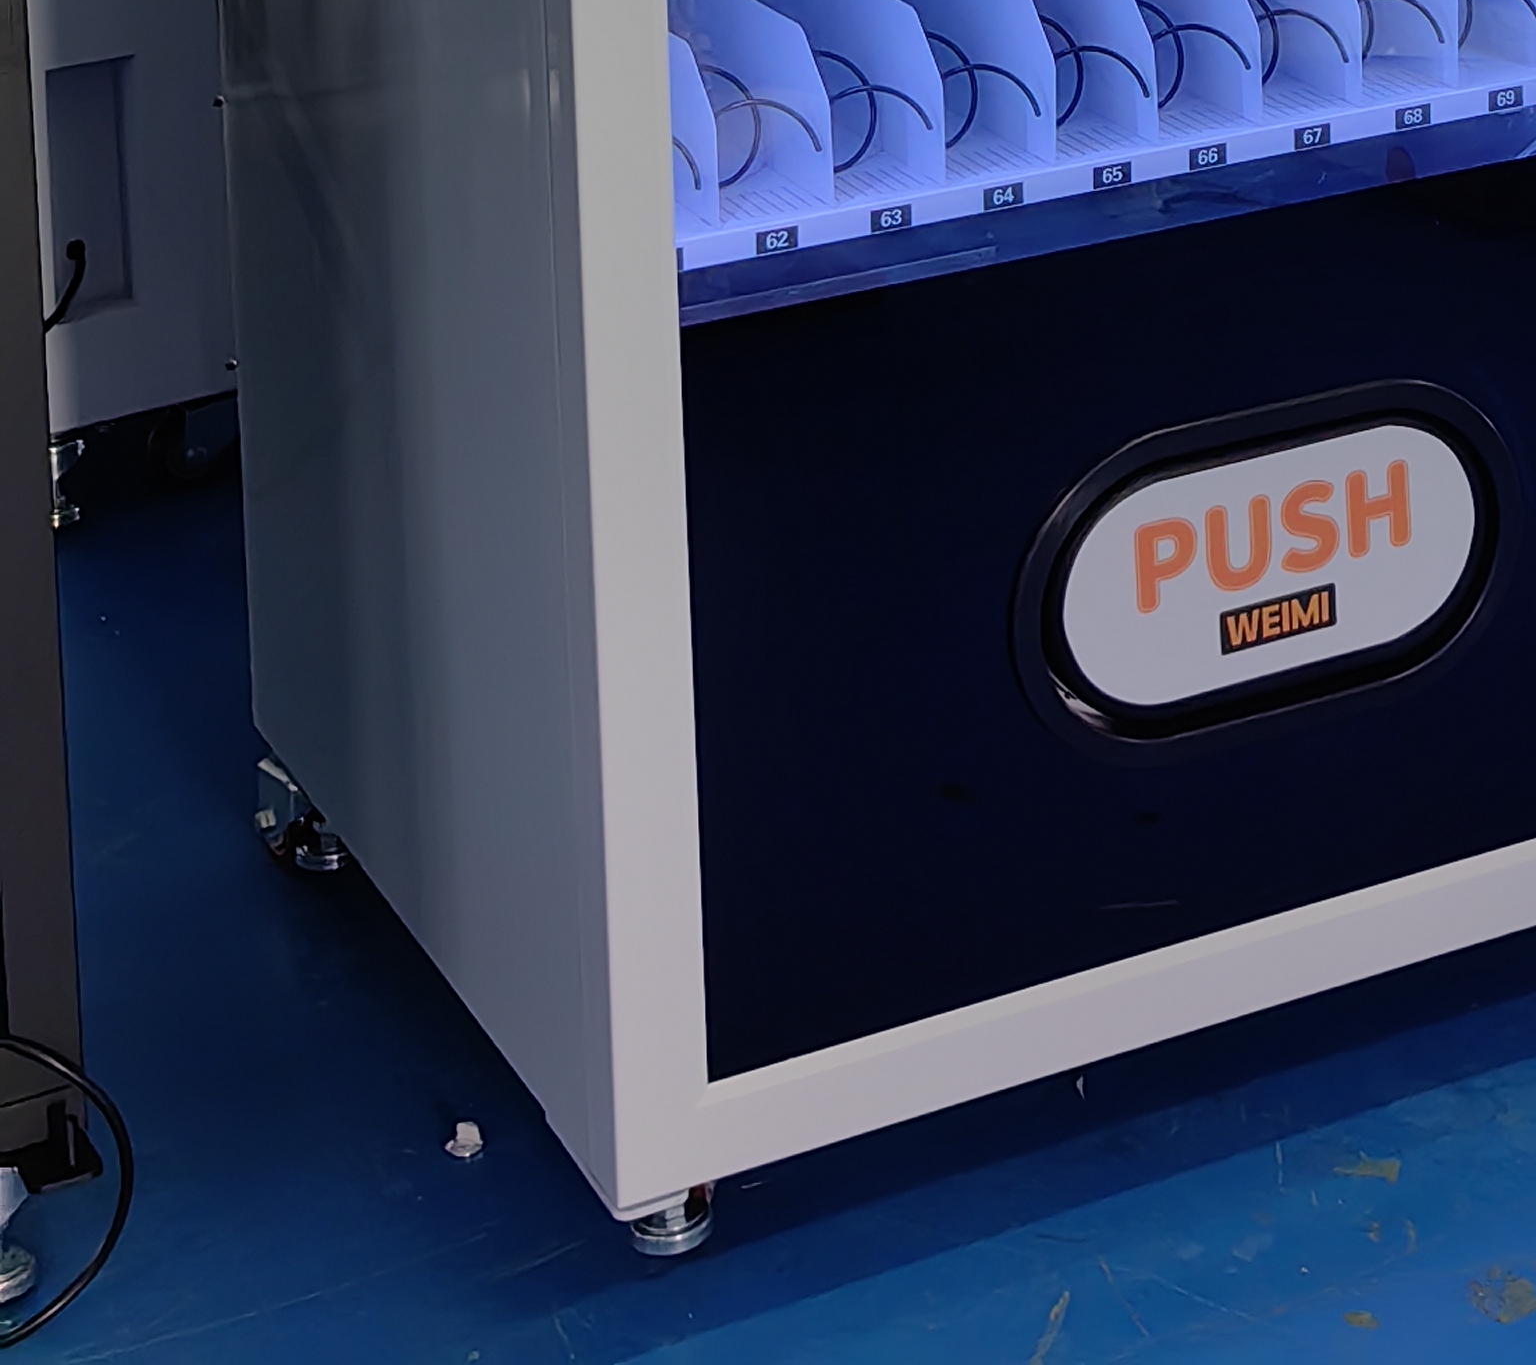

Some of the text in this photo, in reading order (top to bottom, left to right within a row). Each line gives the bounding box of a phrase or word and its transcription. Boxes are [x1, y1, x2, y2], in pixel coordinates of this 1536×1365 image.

[765, 90, 1516, 249] 62 63 64 65 66 67 68 69
[1133, 459, 1412, 614] PUSH
[1226, 591, 1331, 648] WEIMI
